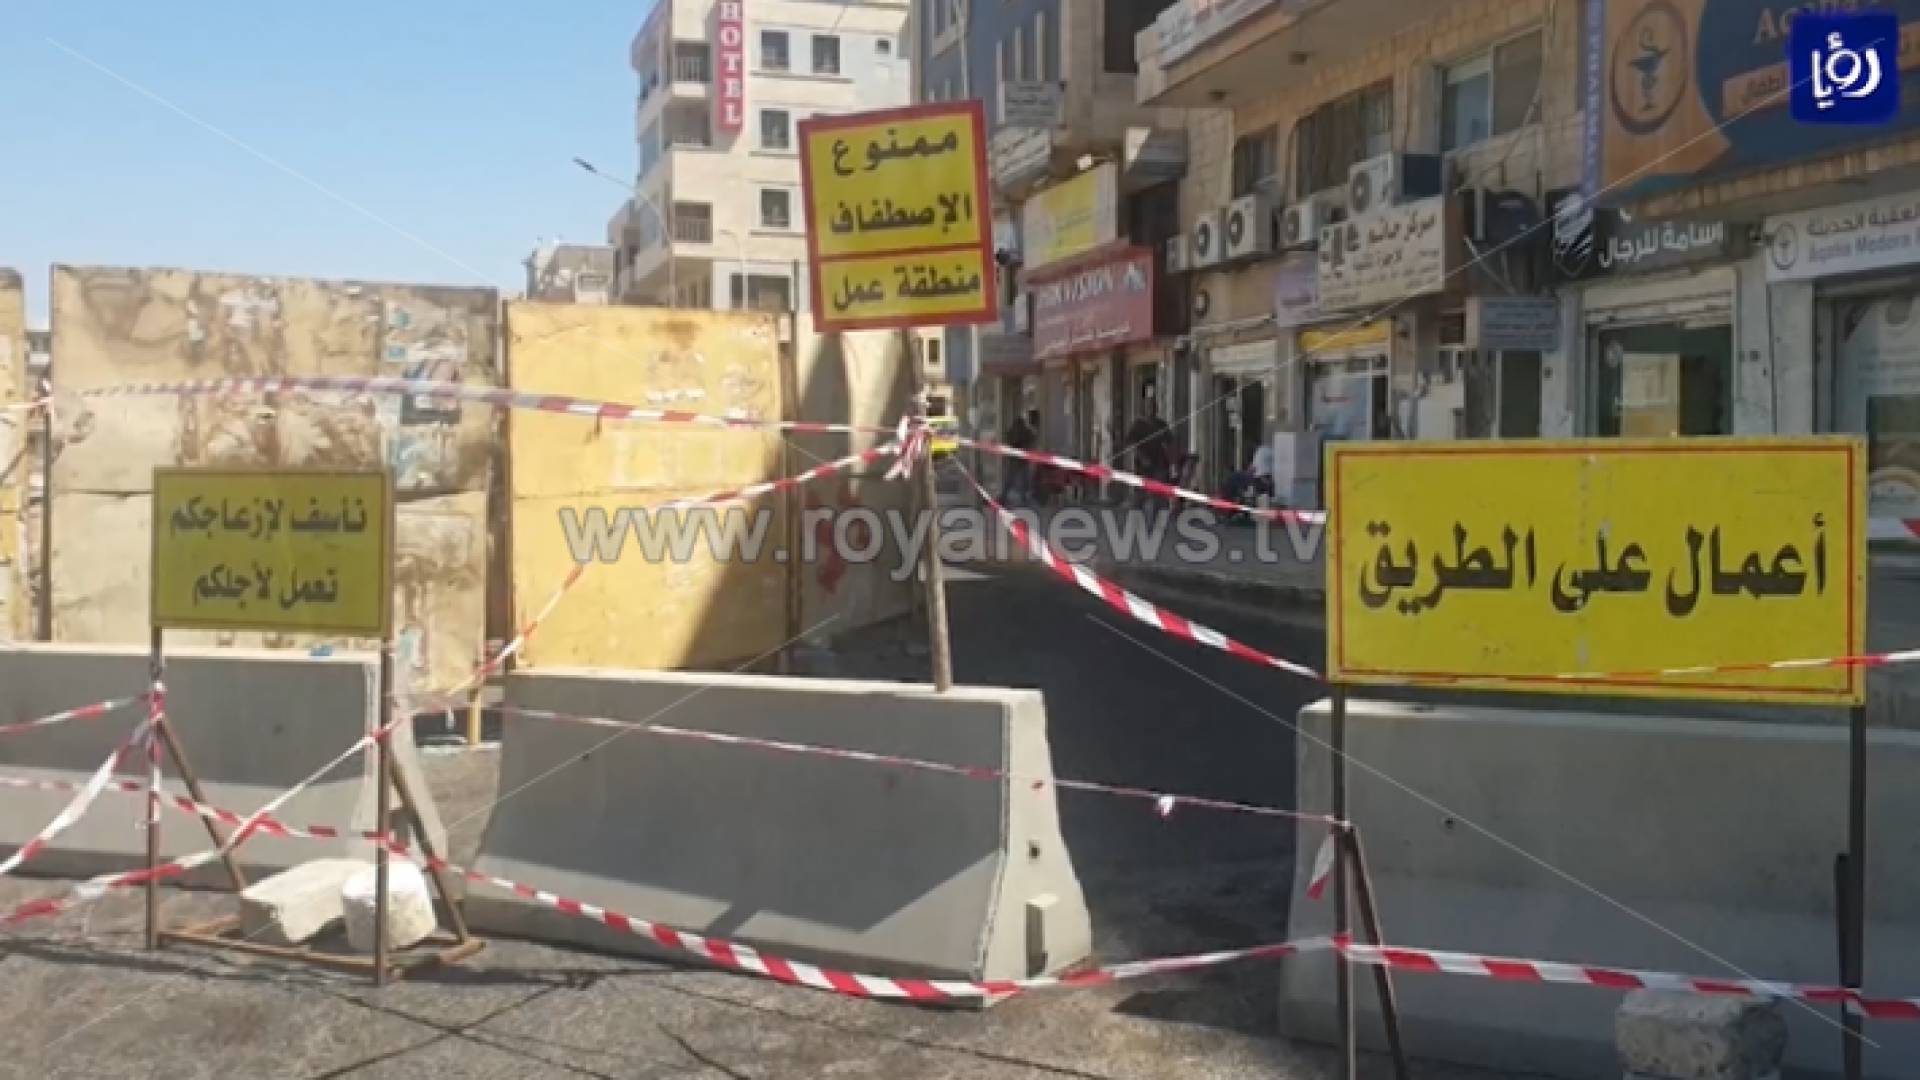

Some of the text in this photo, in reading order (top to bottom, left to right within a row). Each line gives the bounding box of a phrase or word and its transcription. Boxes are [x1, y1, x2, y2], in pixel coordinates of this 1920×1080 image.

[719, 1, 742, 125] HOTEL
[832, 128, 959, 177] ممنوع
[831, 191, 972, 235] الإصطفاف
[833, 263, 981, 312] منطقة عمل
[280, 566, 338, 611] نعمل
[1357, 511, 1826, 617] أعمال على الطريق
